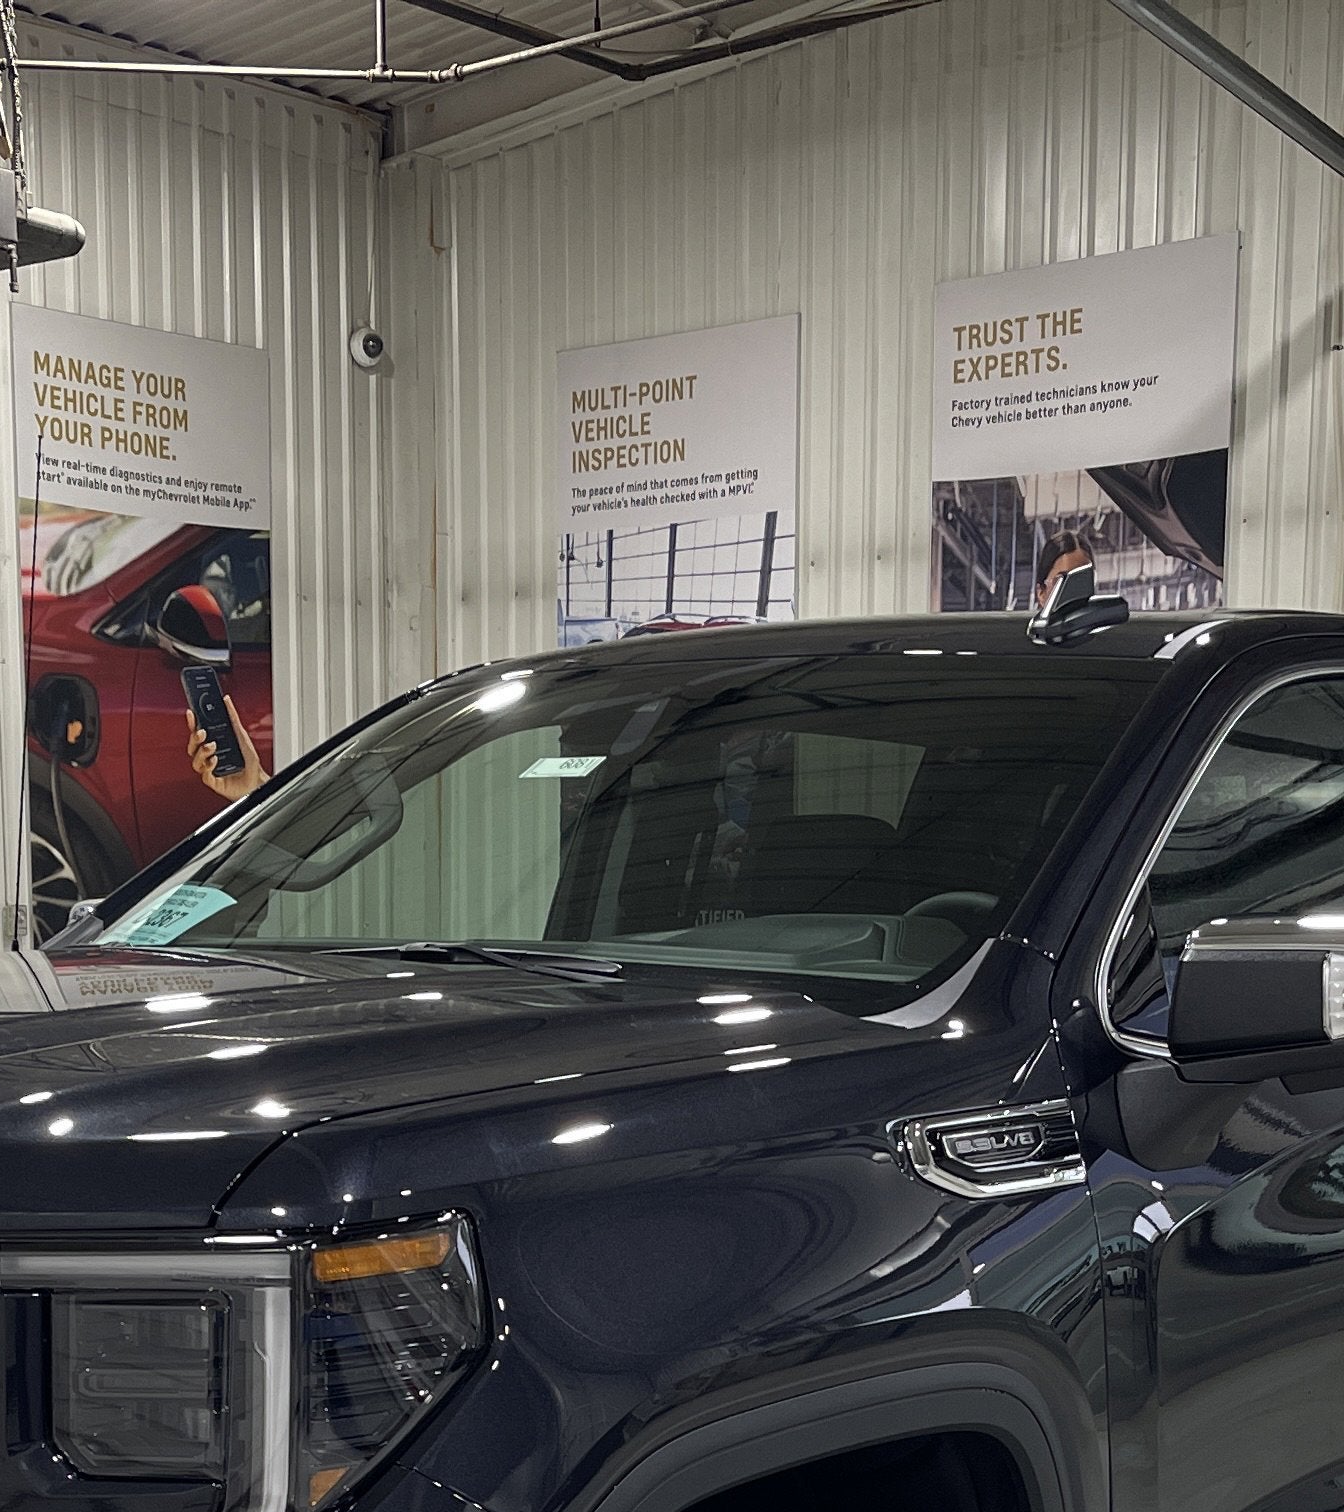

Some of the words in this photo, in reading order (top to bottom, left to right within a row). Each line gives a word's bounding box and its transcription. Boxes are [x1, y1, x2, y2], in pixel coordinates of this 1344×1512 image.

[953, 316, 1029, 351] TRUST
[1036, 307, 1084, 340] THE
[33, 350, 125, 392] MANAGE
[131, 370, 187, 402] YOUR
[953, 346, 1068, 384] EXPERTS.
[33, 382, 125, 423] VEHICLE
[132, 401, 189, 432] FROM
[571, 375, 697, 414] MULTI-POINT
[951, 397, 991, 412] Factory
[994, 391, 1032, 407] trained
[1035, 384, 1097, 402] technicians
[1100, 377, 1130, 393] know
[1132, 375, 1159, 391] your
[571, 412, 651, 443] VEHICLE
[951, 415, 982, 428] Chevy
[985, 409, 1022, 424] vehicle
[1025, 406, 1059, 420] better
[1062, 402, 1086, 415] than
[1089, 396, 1132, 413] anyone.
[34, 413, 93, 448] YOUR
[101, 426, 177, 461] PHONE.
[571, 438, 685, 474] INSPECTION
[61, 459, 107, 475] real-time
[109, 466, 163, 484] diagnostics
[165, 476, 182, 486] and
[184, 478, 209, 492] enjoy
[210, 483, 242, 494] remote
[66, 476, 108, 491] available
[111, 484, 122, 494] on
[125, 484, 140, 496] the
[142, 489, 200, 504] myChevrolet
[202, 495, 231, 508] Mobile
[572, 488, 587, 499] The
[589, 487, 613, 499] peace
[616, 482, 625, 494] of
[627, 480, 647, 493] mind
[650, 478, 668, 489] that
[670, 478, 698, 488] comes
[701, 473, 722, 484] from
[725, 468, 758, 484] getting
[571, 504, 590, 517] your
[592, 498, 628, 512] vehicle's
[630, 495, 657, 508] health
[659, 490, 696, 504] checked
[698, 488, 718, 500] with
[720, 490, 726, 498] a
